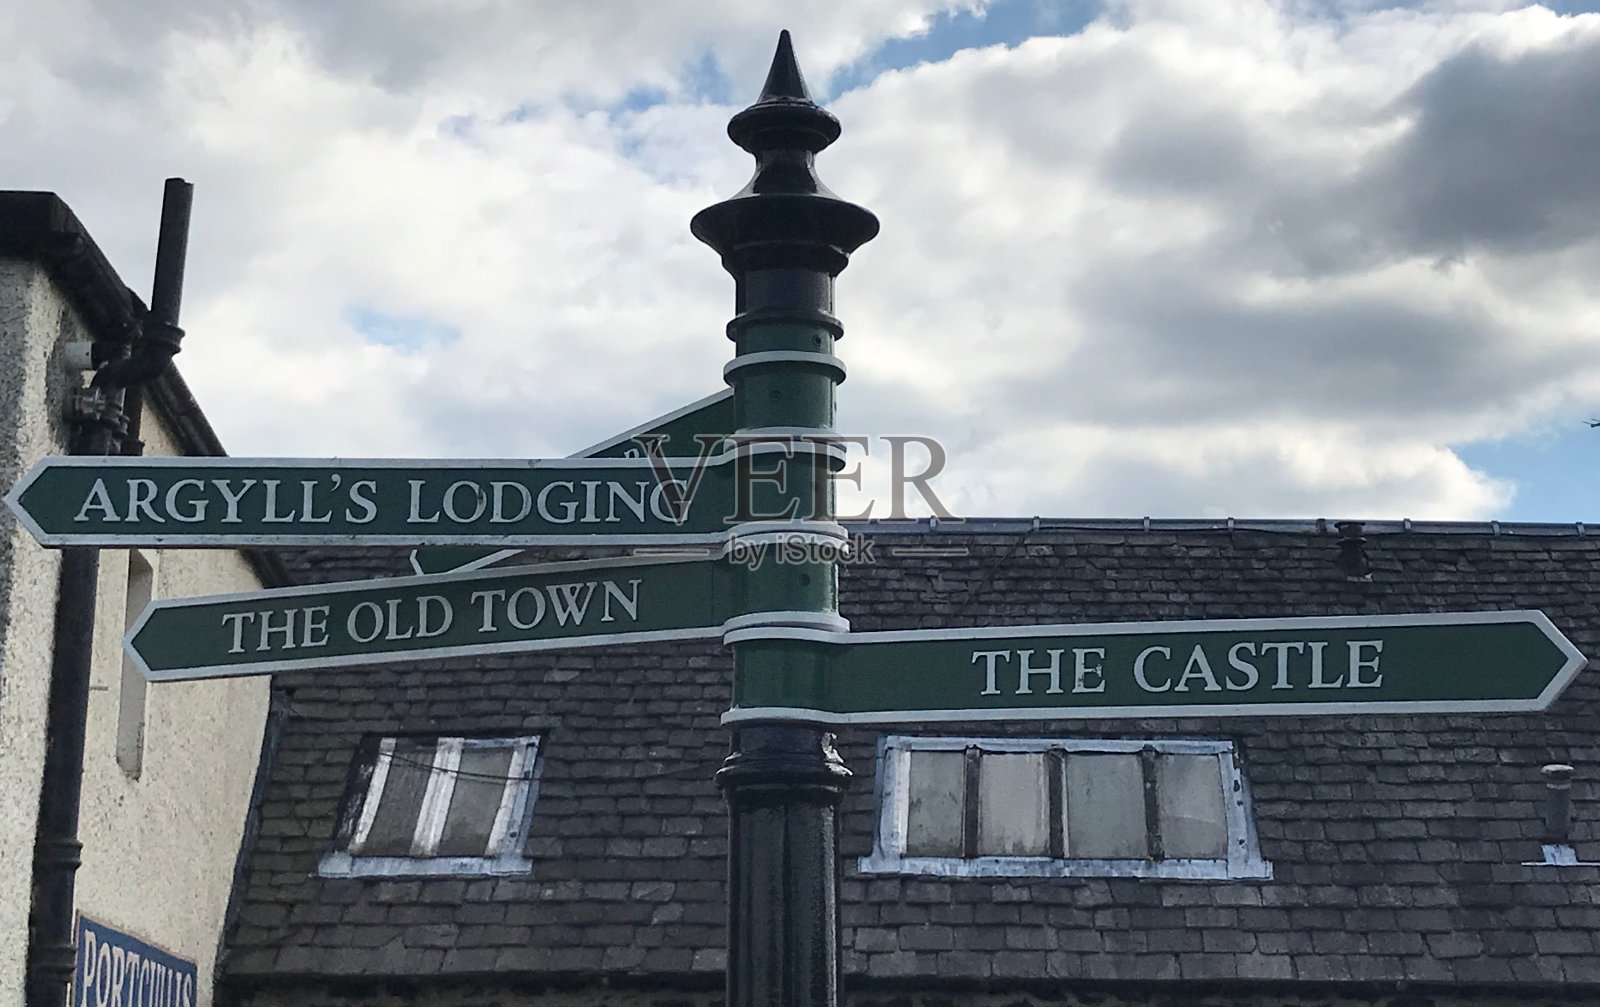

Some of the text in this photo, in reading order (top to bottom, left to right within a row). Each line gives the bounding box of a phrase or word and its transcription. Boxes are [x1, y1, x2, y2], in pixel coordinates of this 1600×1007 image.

[73, 474, 690, 524] ARGYLL'S LODGING
[221, 579, 643, 654] THE OLD TOWN
[971, 639, 1385, 695] THE CASTLE
